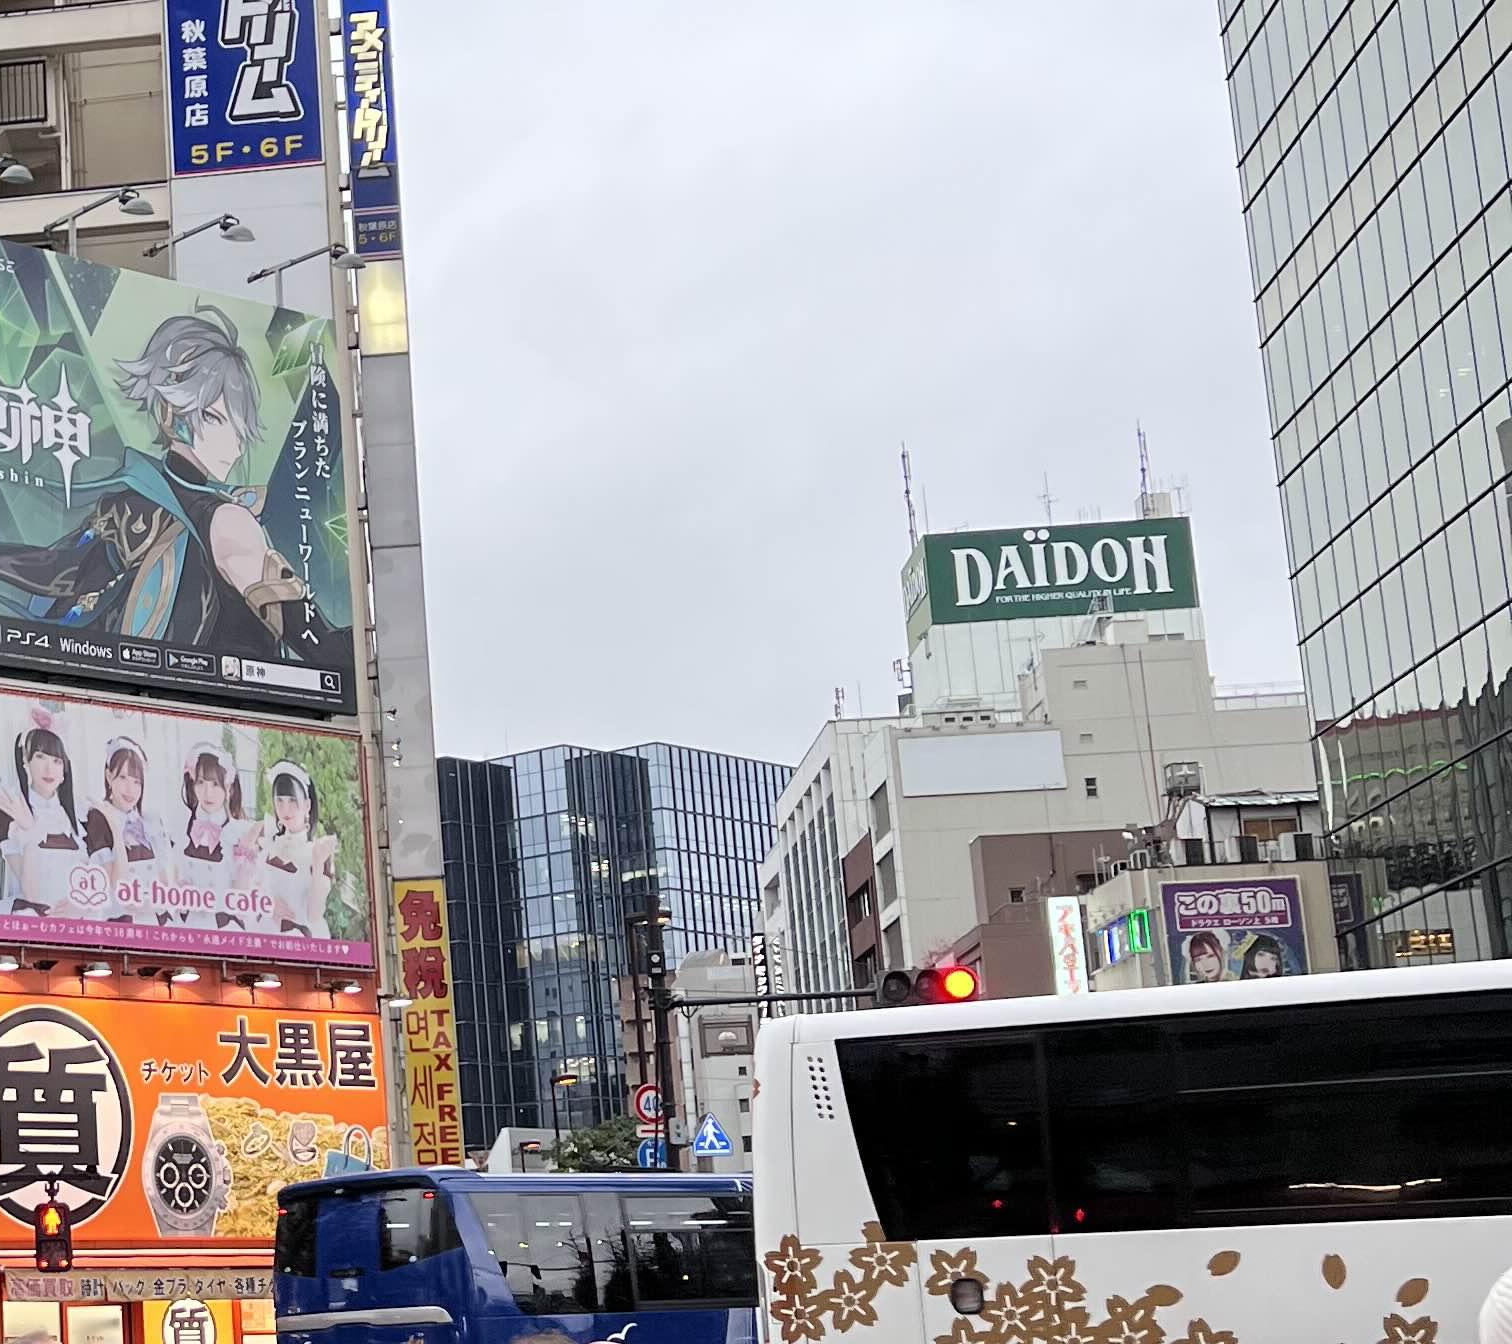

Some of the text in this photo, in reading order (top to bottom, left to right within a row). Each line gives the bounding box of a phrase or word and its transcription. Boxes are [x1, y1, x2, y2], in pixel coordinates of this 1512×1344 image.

[181, 18, 209, 128] 秋葉原店
[310, 342, 331, 479] 冒険に満ちた
[1031, 591, 1064, 602] HIGHER
[1112, 587, 1132, 597] LIFE
[6, 628, 51, 648] PS4
[59, 637, 113, 659] Windows
[245, 664, 266, 679] 原神
[225, 888, 273, 913] cafe
[399, 889, 448, 1000] 免税
[141, 1059, 210, 1084] チケット
[217, 1014, 378, 1090] 大黒屋
[406, 1009, 438, 1166] 면세점
[430, 1008, 461, 1165] TAX FREE
